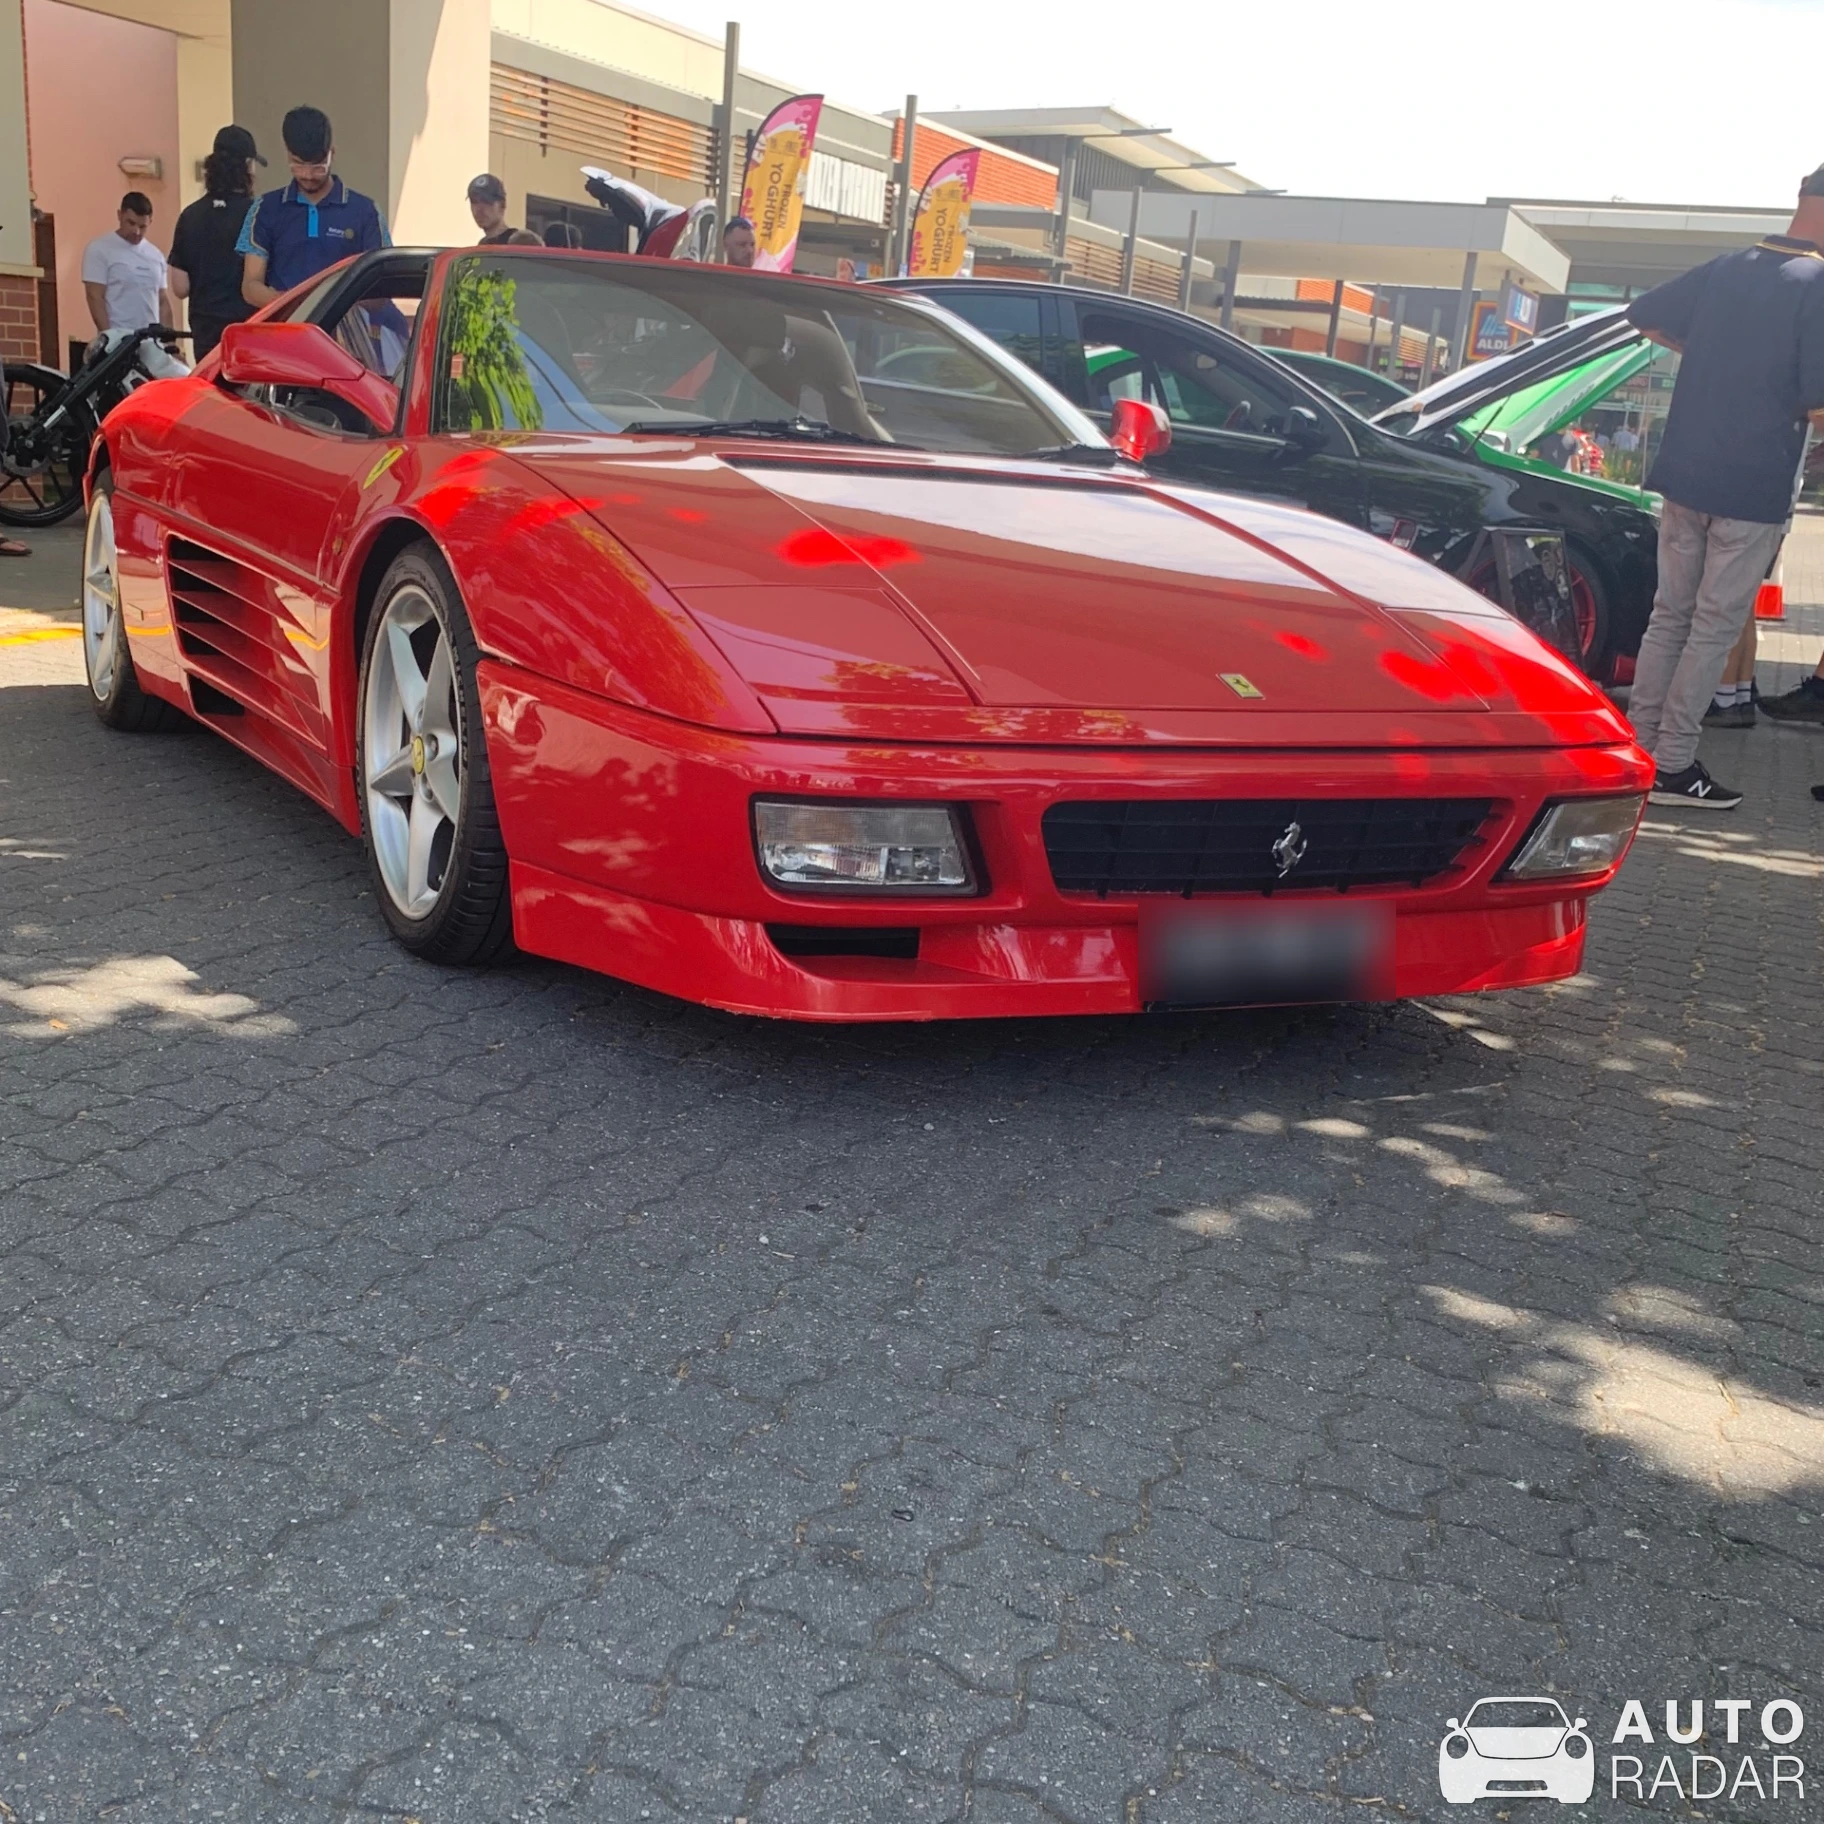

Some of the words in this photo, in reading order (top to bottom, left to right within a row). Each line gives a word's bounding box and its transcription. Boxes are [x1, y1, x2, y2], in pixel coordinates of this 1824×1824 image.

[760, 163, 784, 241] YOGHURT
[777, 184, 792, 229] FROZEN
[929, 208, 948, 274] YOGHURT
[943, 225, 956, 263] FROZEN
[1477, 338, 1508, 350] ALDI
[1687, 779, 1712, 798] N
